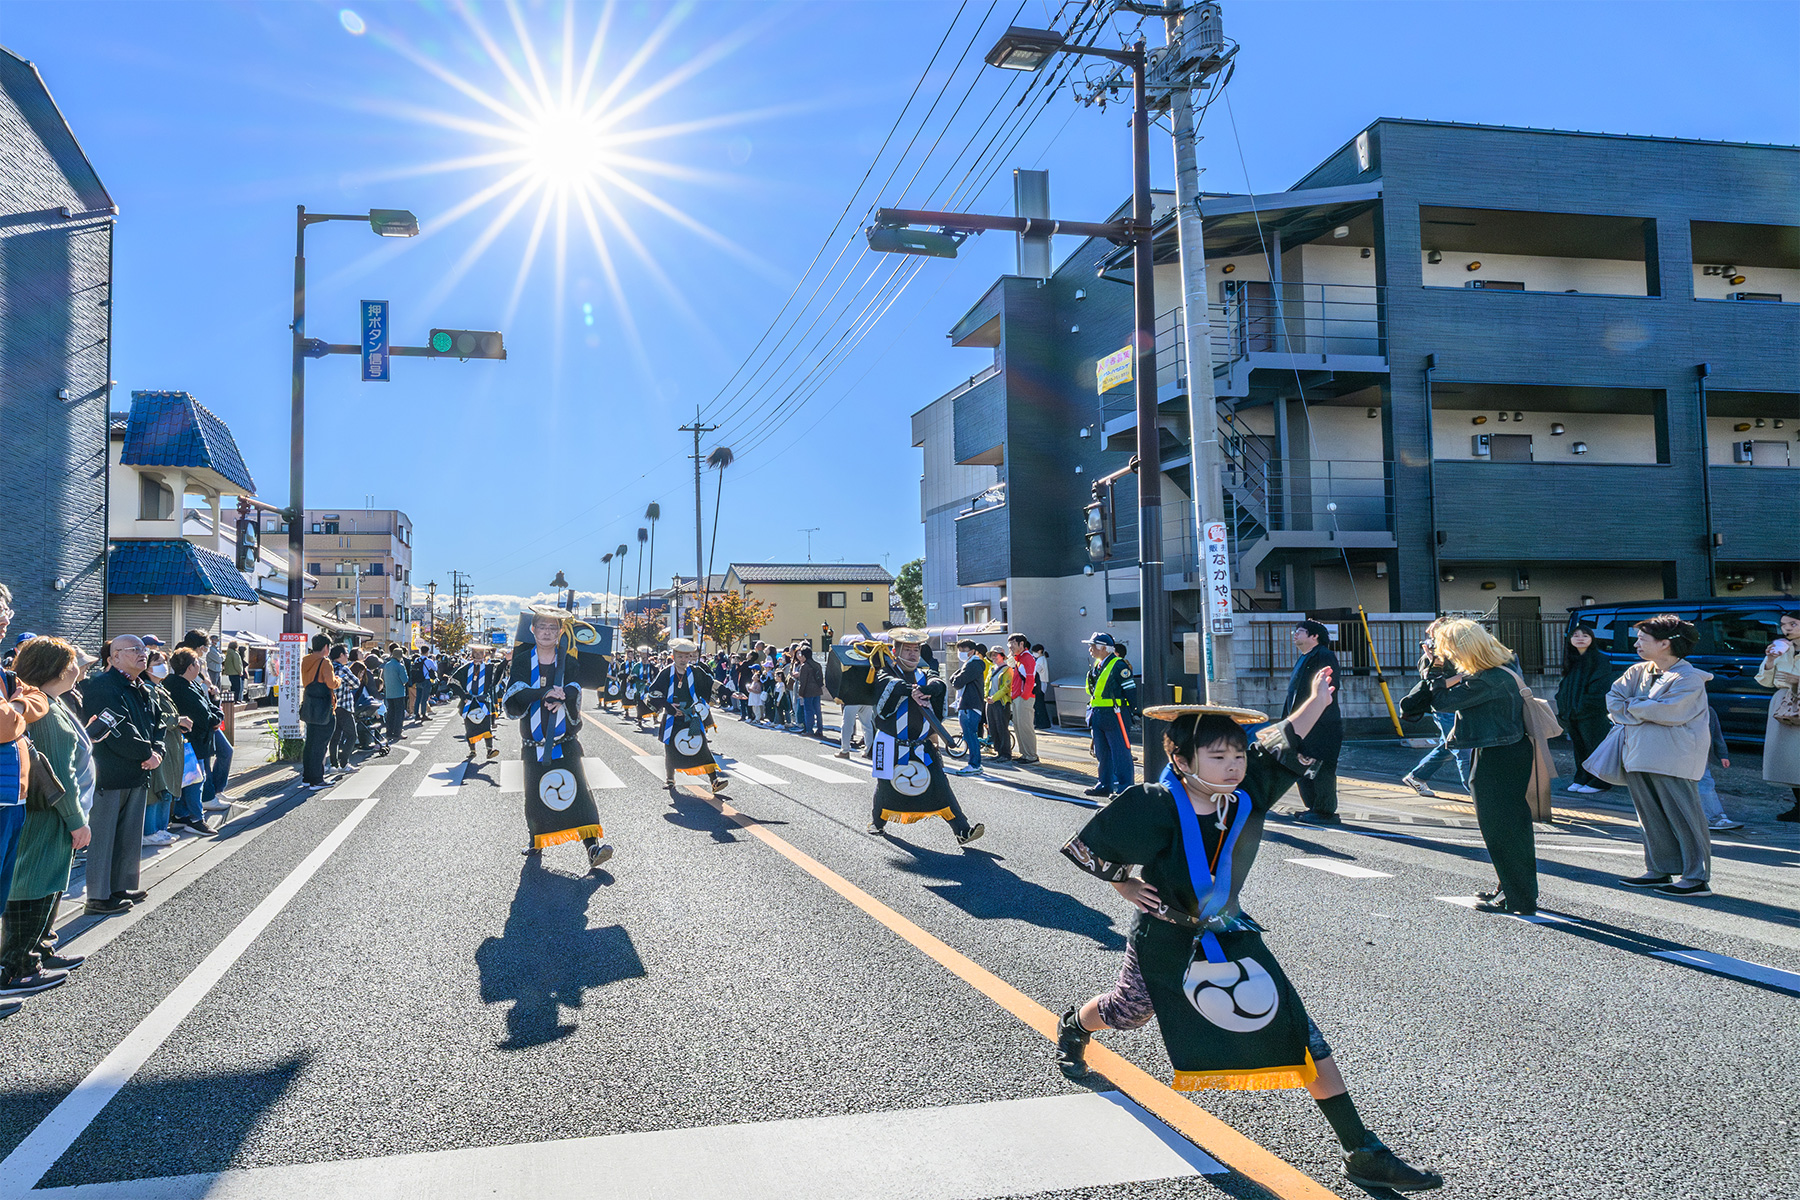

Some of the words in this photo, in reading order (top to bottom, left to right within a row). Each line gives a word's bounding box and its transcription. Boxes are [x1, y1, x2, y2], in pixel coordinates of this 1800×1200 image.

[368, 304, 382, 377] 押ボタン信号
[1212, 554, 1228, 596] なかや
